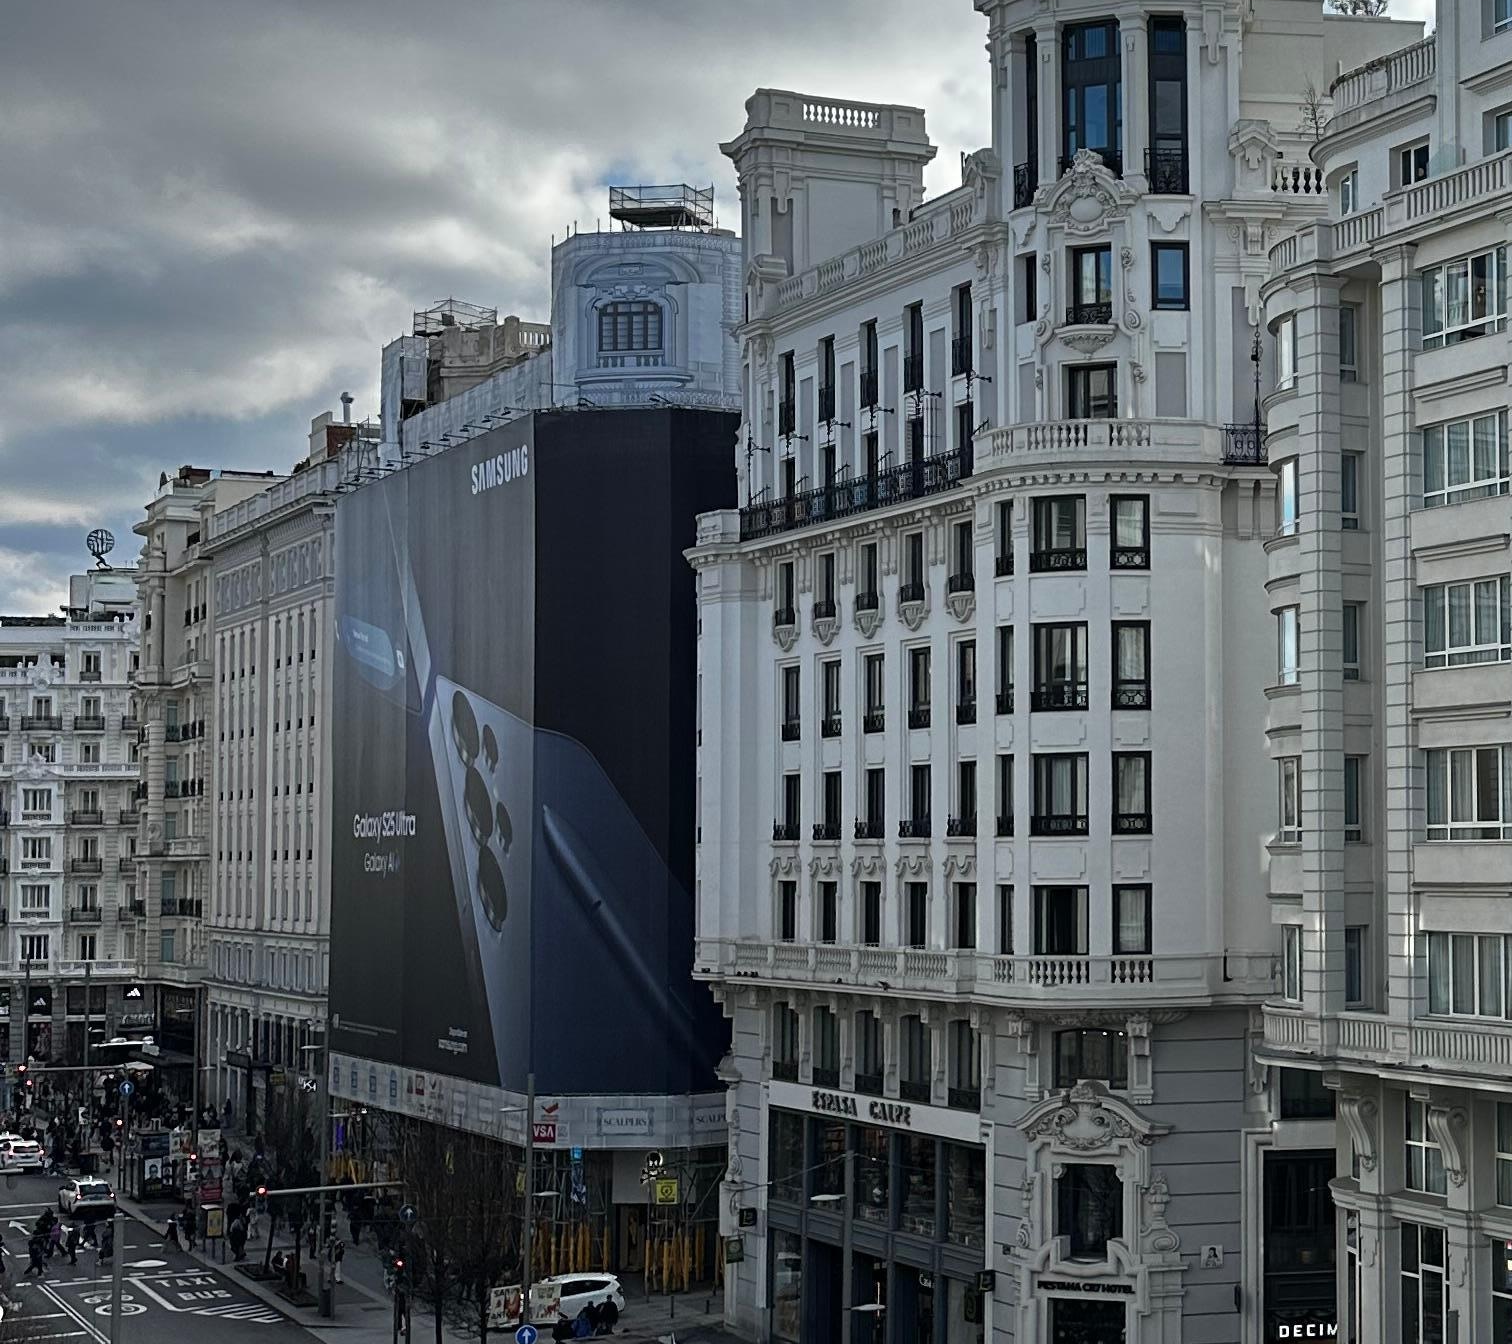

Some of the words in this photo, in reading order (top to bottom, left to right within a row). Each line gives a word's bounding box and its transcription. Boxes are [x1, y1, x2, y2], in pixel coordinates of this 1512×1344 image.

[471, 444, 528, 495] SAMSUNG
[353, 813, 382, 844] Galaxy
[382, 811, 395, 836] S25
[395, 810, 416, 836] Ultra
[364, 852, 388, 878] Galaxy
[812, 1090, 857, 1117] ESPASA
[869, 1101, 911, 1127] CALPE
[603, 1117, 647, 1127] SCALPERS
[155, 1276, 217, 1288] TAXI
[177, 1289, 233, 1301] BUS
[1279, 1323, 1338, 1338] DECIM
